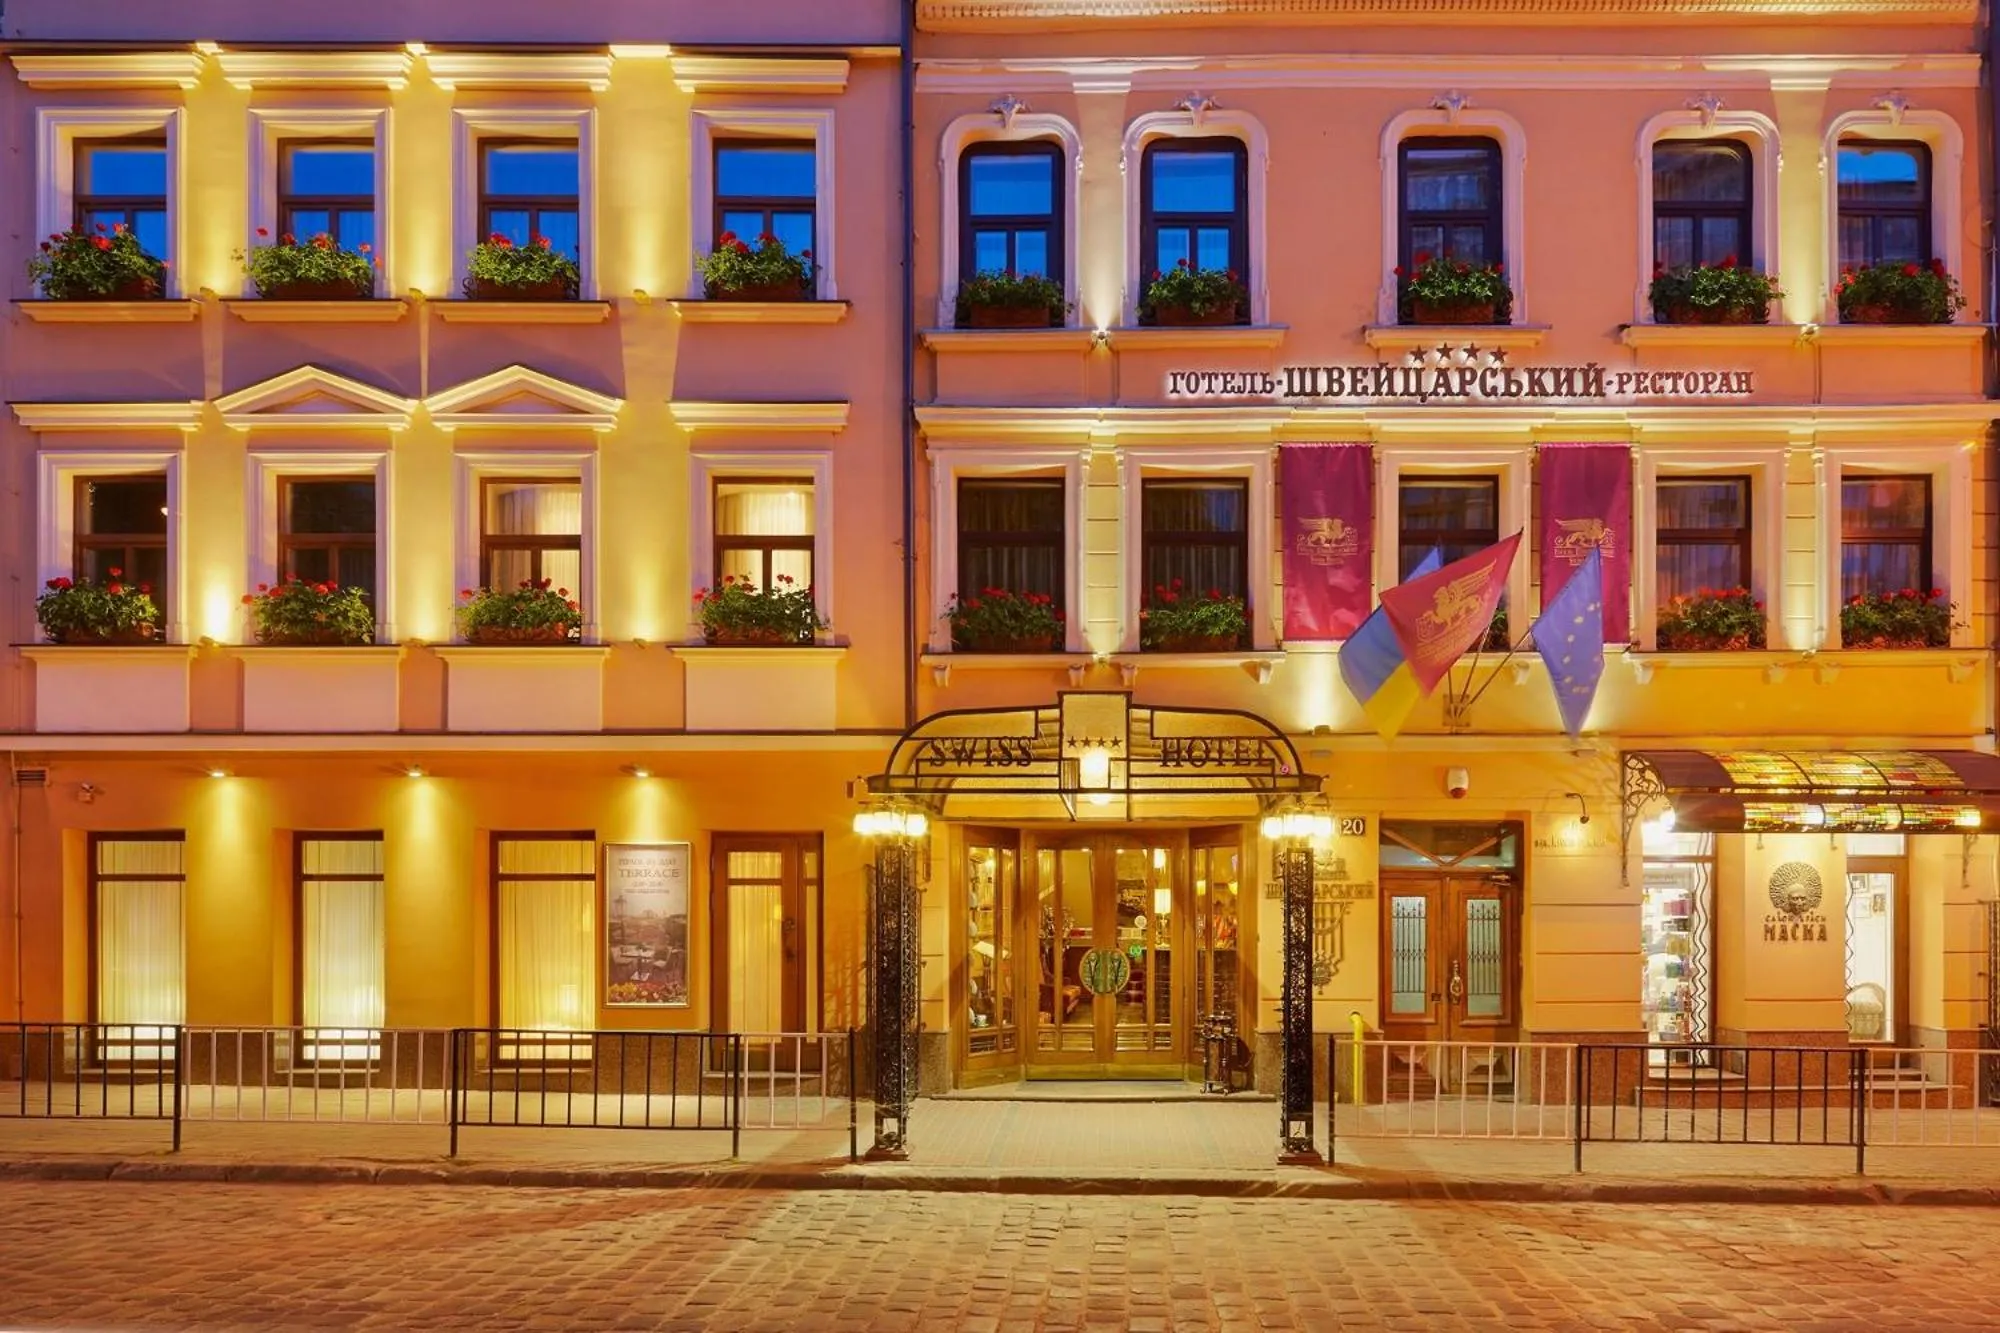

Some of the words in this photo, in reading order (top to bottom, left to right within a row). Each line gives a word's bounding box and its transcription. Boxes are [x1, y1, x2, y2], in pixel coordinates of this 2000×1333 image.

[929, 736, 1032, 767] SWISS
[1159, 736, 1273, 768] HOTEL
[1343, 818, 1364, 835] 20
[618, 868, 682, 878] TERRACE
